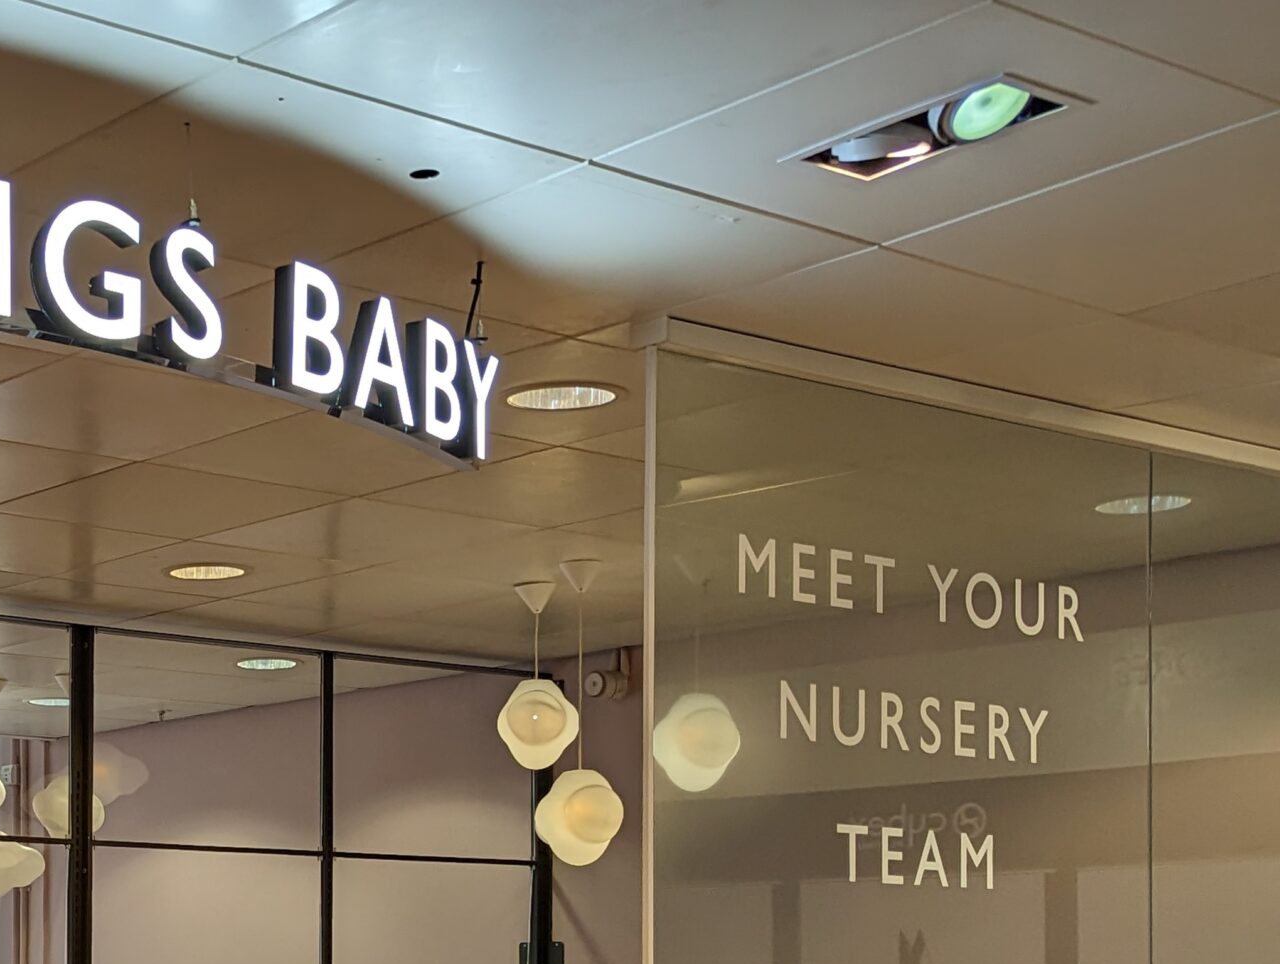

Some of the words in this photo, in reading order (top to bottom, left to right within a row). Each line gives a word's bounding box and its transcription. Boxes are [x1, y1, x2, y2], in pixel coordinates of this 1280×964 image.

[289, 259, 500, 462] BABY
[739, 534, 895, 613] MEET
[928, 565, 1084, 642] YOUR
[781, 680, 1048, 763] NURSERY
[837, 824, 993, 889] TEAM
